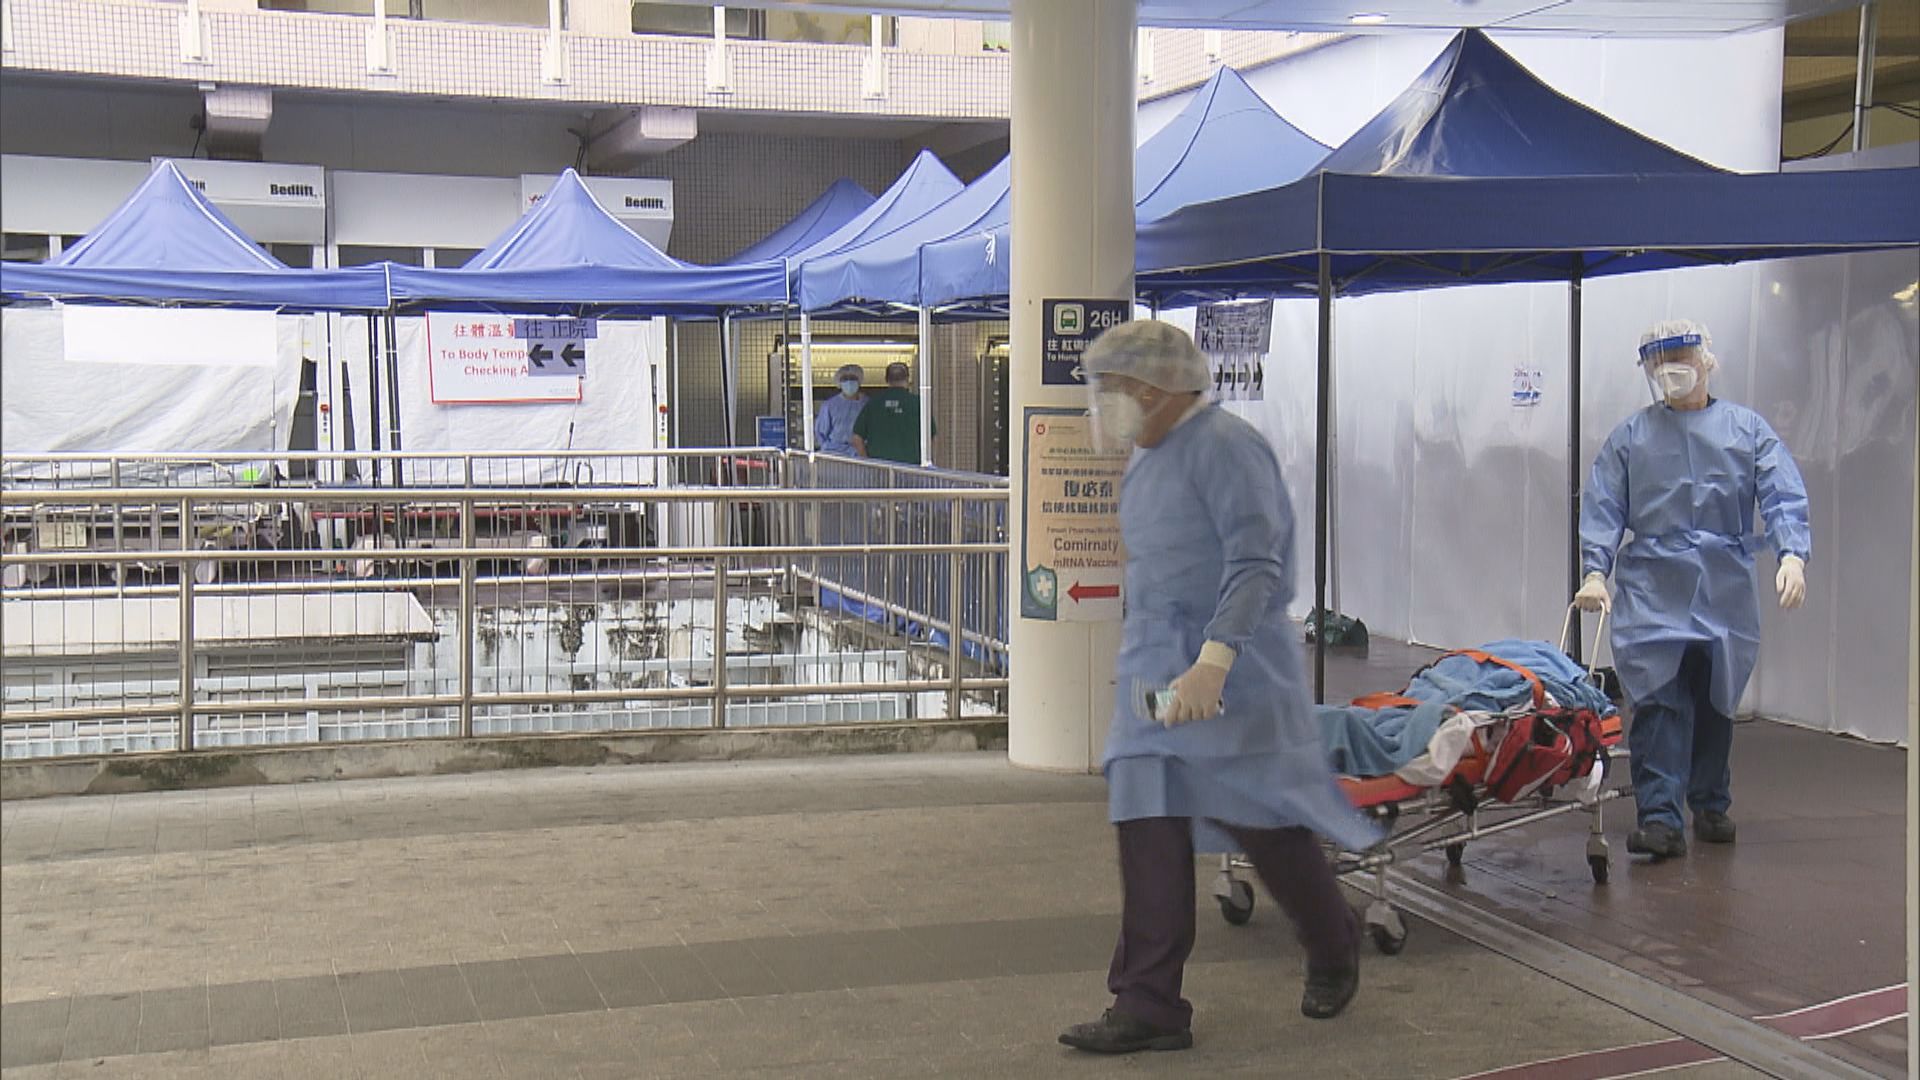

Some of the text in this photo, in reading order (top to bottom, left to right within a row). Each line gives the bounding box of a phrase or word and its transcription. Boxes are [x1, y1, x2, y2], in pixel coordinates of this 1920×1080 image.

[270, 184, 314, 197] Bedlift
[625, 196, 664, 209] Bedlift
[1090, 310, 1121, 328] 26H
[442, 348, 528, 361] To Body Temp
[465, 366, 516, 378] Checking
[1054, 538, 1119, 555] Comirnaty
[1053, 557, 1119, 568] mRNA Vaccine
